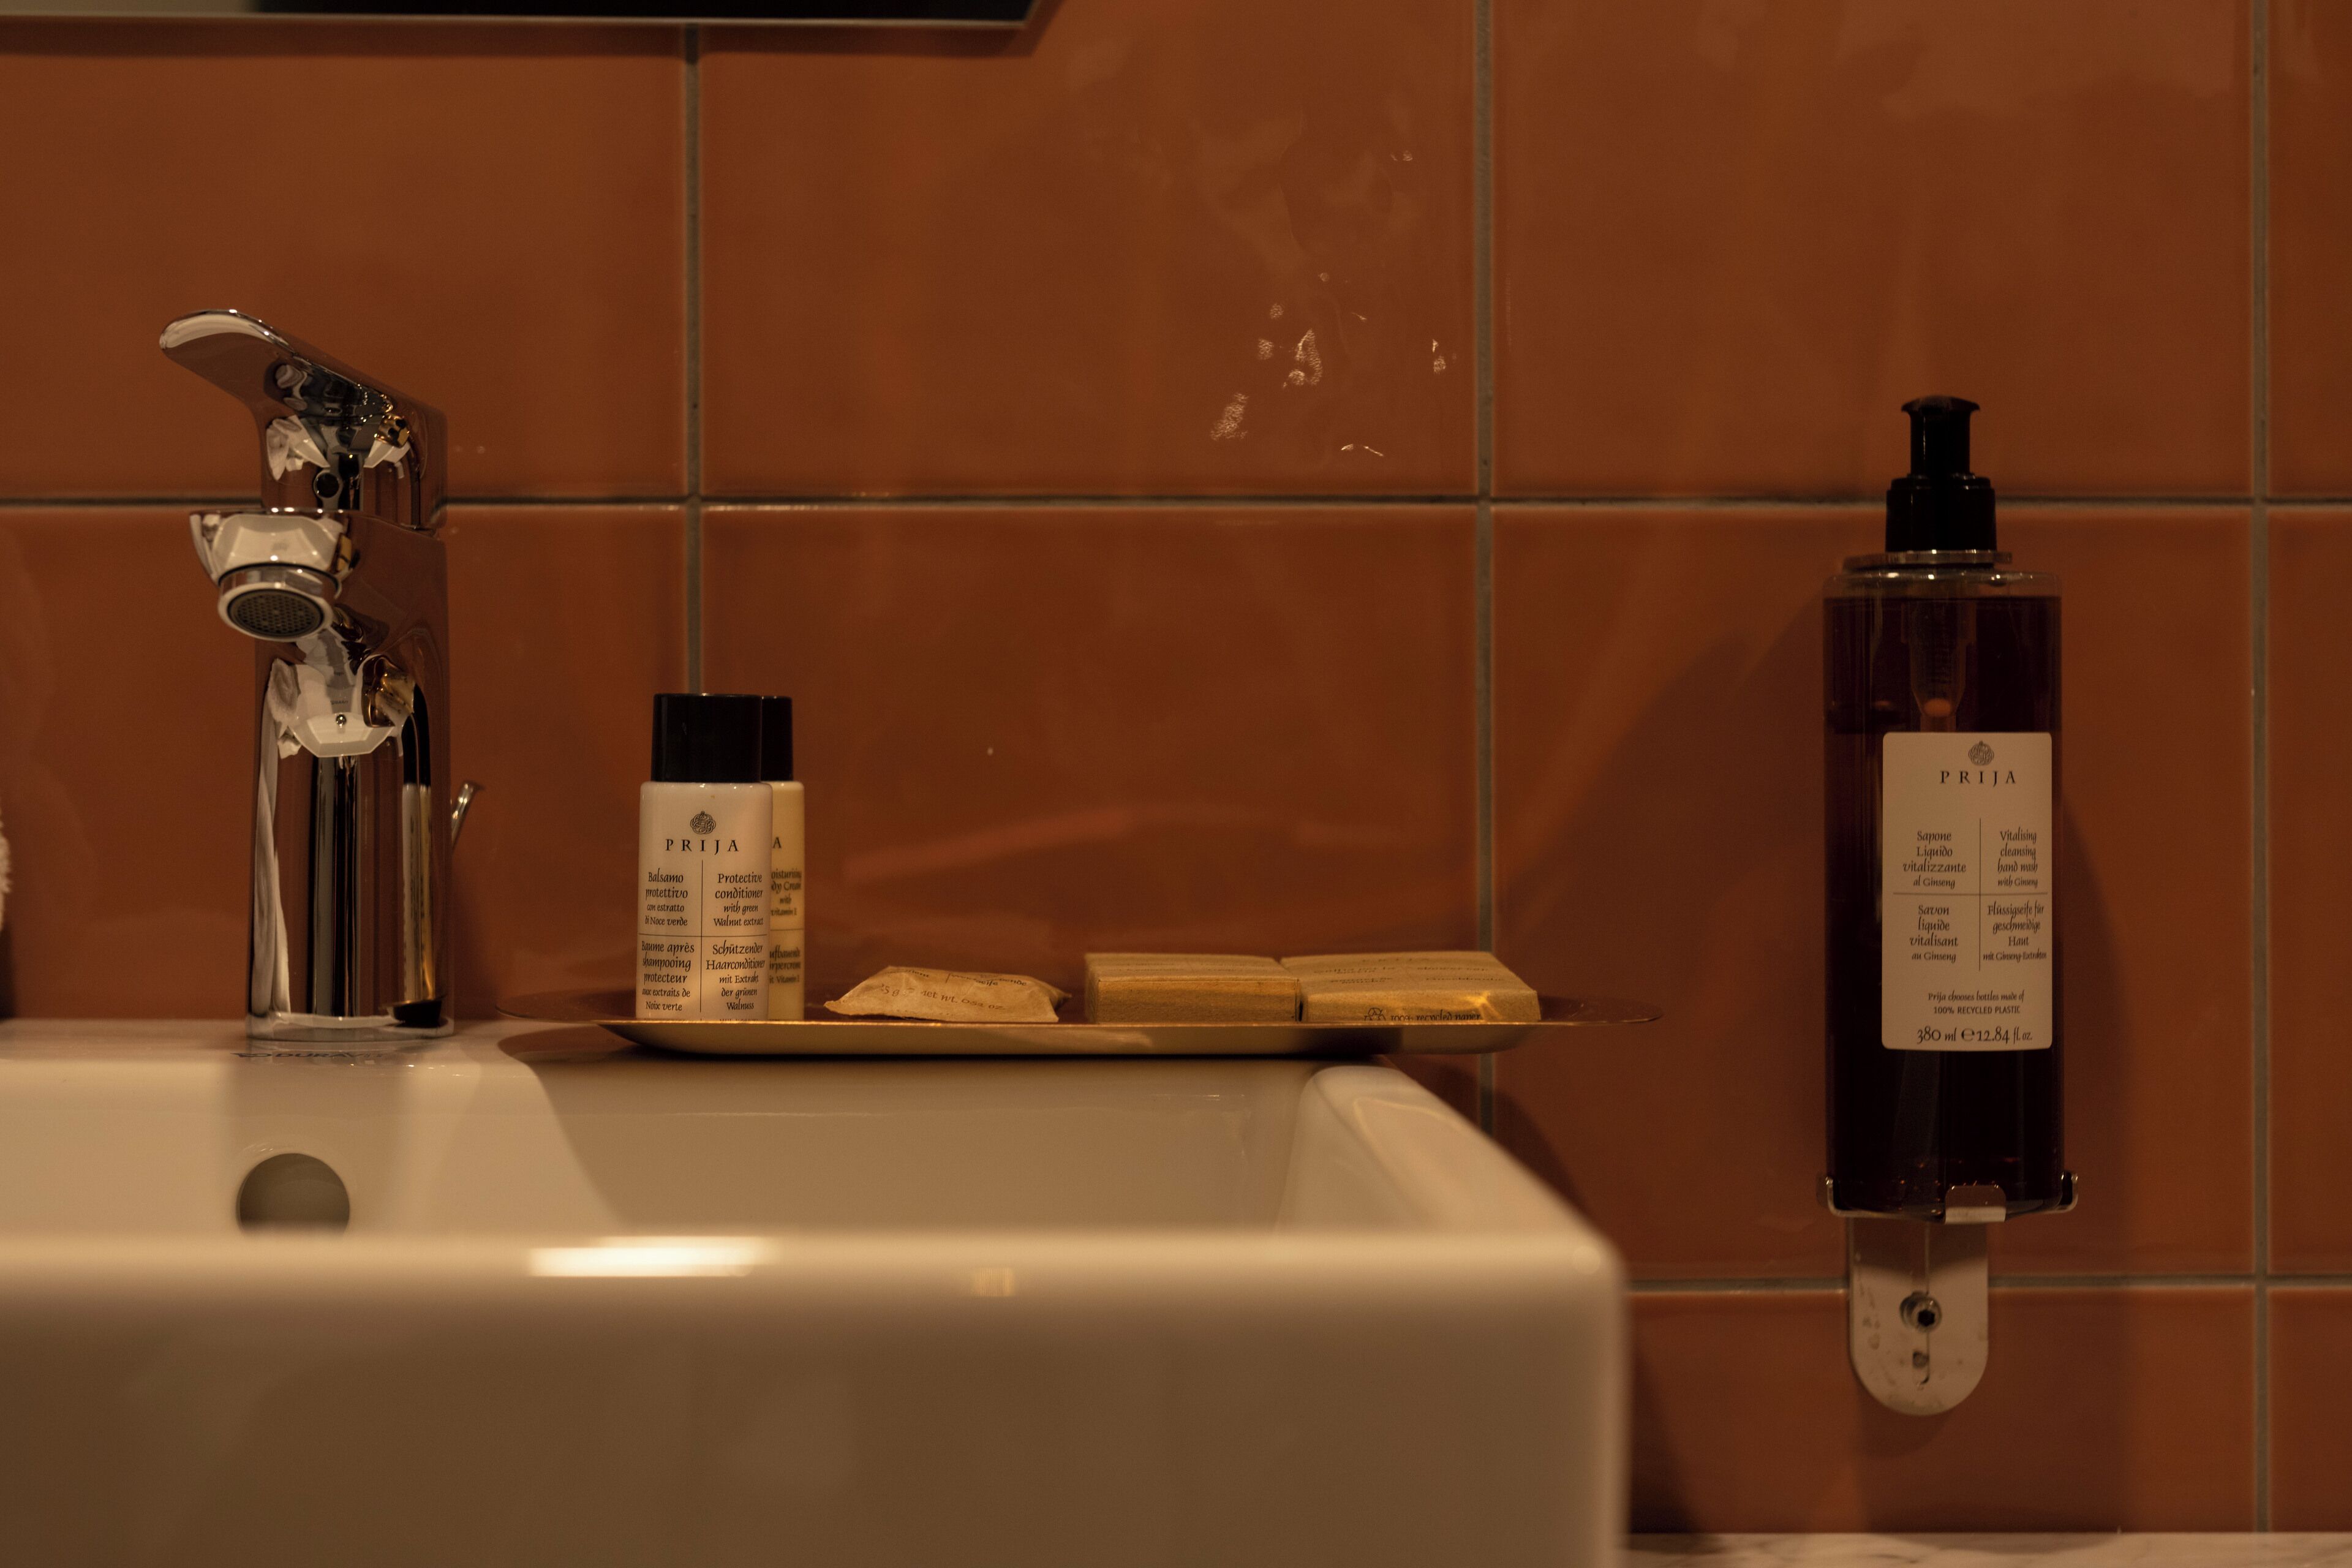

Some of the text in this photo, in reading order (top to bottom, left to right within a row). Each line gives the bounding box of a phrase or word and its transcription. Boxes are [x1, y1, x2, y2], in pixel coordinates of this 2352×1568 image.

[1940, 770, 2016, 787] PRIJA
[1917, 831, 1952, 844] Sapone
[2000, 827, 2037, 844] Vitalising
[665, 839, 739, 855] PRIJA
[1917, 845, 1953, 859] Liquido
[2000, 843, 2037, 859] cleansing
[1903, 859, 1967, 872] vitalizzante
[1997, 858, 2038, 873] hand wash
[648, 868, 684, 883] Balsamo
[717, 872, 763, 884] Protective
[1913, 875, 1956, 889] al Ginseng
[1998, 876, 2038, 889] with Ginseng
[646, 887, 688, 901] protettivo
[715, 888, 763, 899] conditioner
[657, 903, 685, 913] estratto
[723, 900, 758, 915] with green
[1918, 905, 1949, 916] Savon
[1987, 900, 2044, 919] Flüssigseife für
[650, 916, 665, 925] Noce
[666, 916, 688, 926] verde
[714, 915, 742, 926] Walnut
[1918, 916, 1950, 934] liquide
[1992, 916, 2041, 935] geschmeidige
[1910, 932, 1959, 946] vitalisant
[2008, 936, 2029, 946] Haut
[641, 941, 695, 956] Baume après
[712, 940, 763, 956] Schützender
[642, 951, 691, 972] shampooing
[1923, 951, 1956, 963] Ginseng
[1983, 951, 1994, 961] mit
[706, 957, 766, 970] Haarconditioner
[644, 974, 687, 985] protecteur
[719, 971, 759, 984] mit Extrakt
[652, 989, 680, 997] extraits
[682, 989, 690, 997] de
[721, 987, 757, 999] der grünen
[1928, 989, 2024, 1003] Prija chooses bottles made of
[646, 1001, 682, 1011] Noix verte
[726, 998, 754, 1010] Walnuss
[1995, 1006, 2020, 1014] PLASTIC
[1917, 1025, 1942, 1044] 380
[1945, 1027, 1957, 1042] ml
[1977, 1026, 2010, 1044] 12.84
